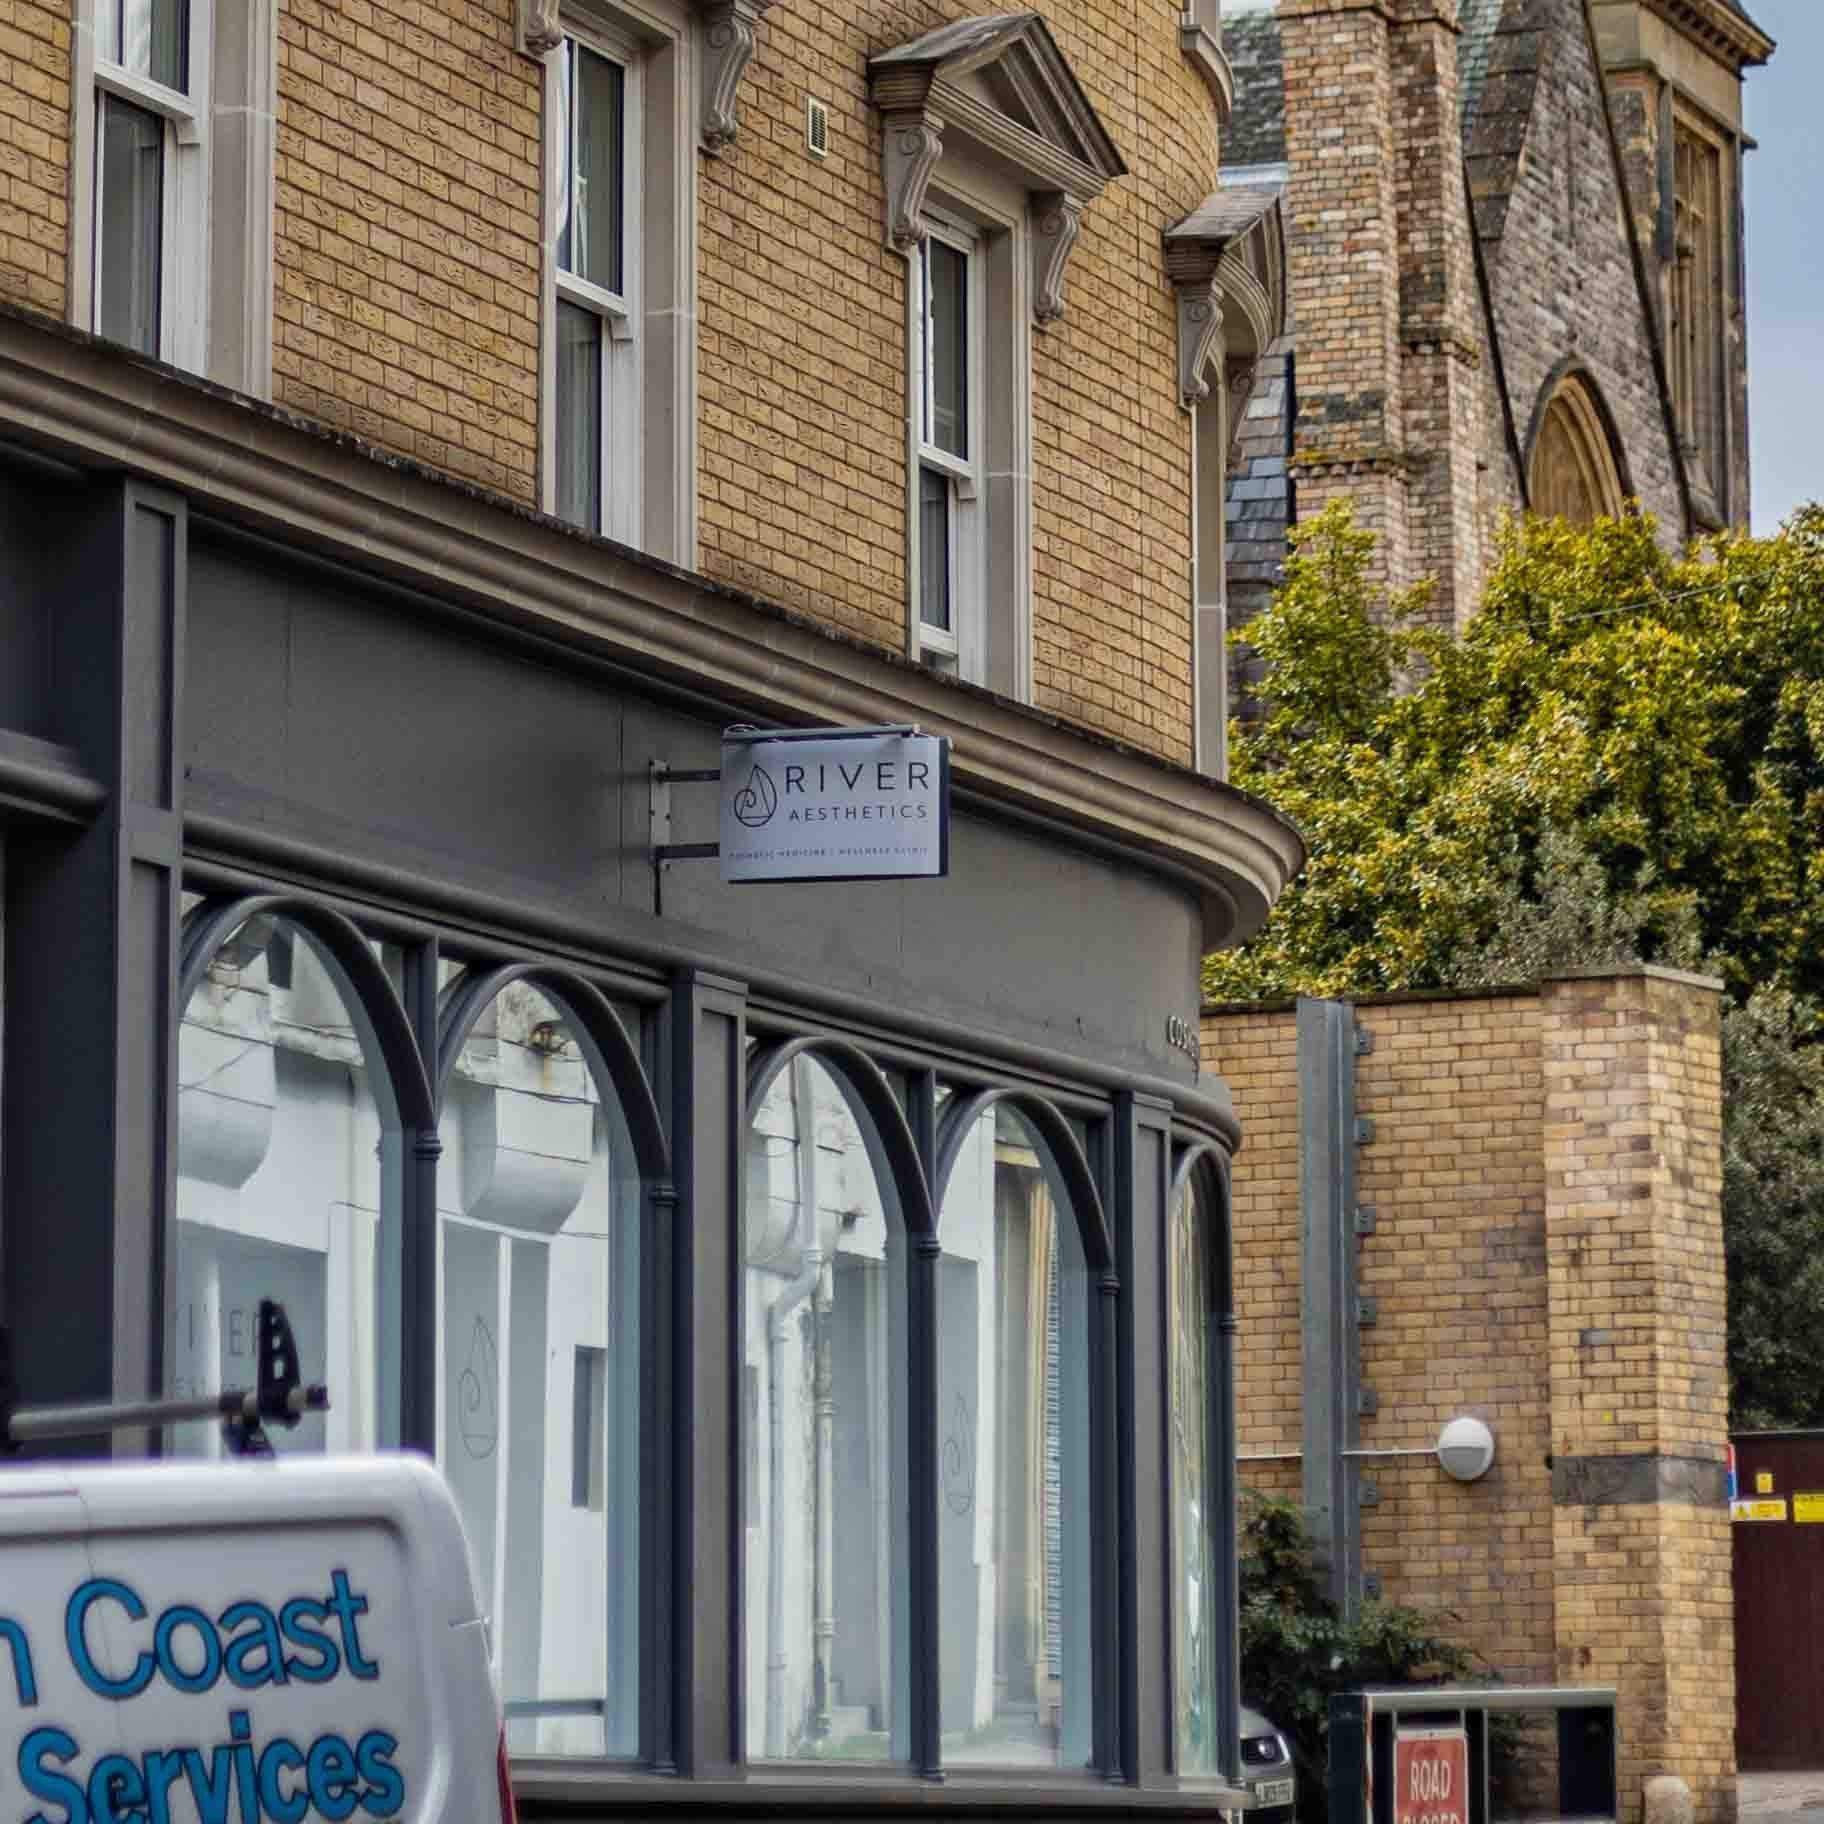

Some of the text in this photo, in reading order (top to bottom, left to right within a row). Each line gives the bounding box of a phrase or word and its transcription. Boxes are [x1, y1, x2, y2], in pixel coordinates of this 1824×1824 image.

[785, 762, 930, 795] RIVER
[789, 804, 928, 823] AESTHETICS
[64, 1568, 380, 1702] Coast
[17, 1709, 406, 1824] Services
[1410, 1759, 1451, 1801] ROAD
